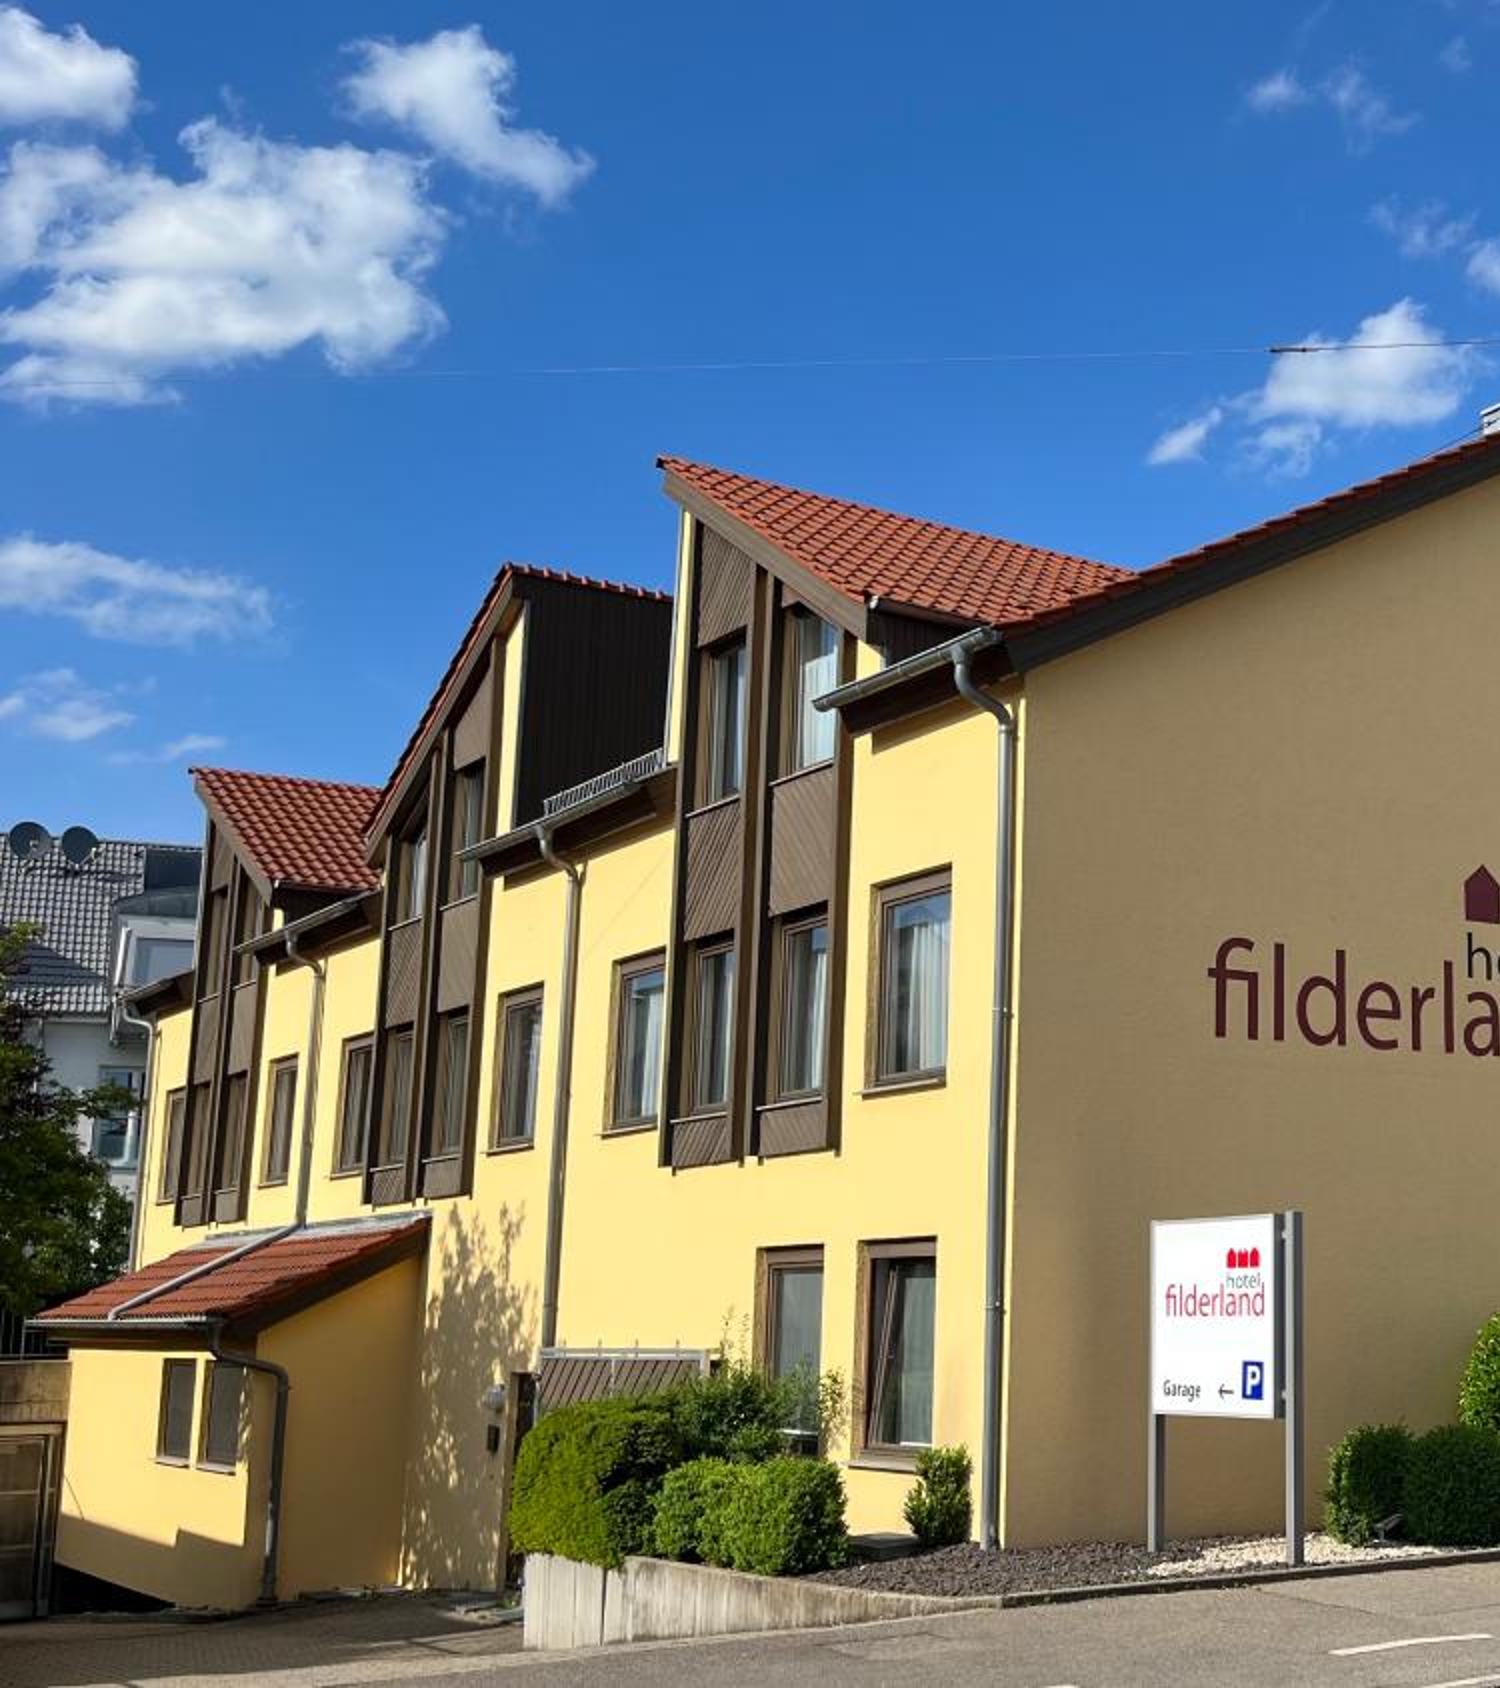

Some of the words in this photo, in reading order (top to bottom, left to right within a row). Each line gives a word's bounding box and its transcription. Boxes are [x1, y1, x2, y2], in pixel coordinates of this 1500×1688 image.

[1226, 1273, 1260, 1288] hotel
[1165, 1283, 1264, 1316] filderland
[1163, 1379, 1201, 1402] Garage
[1246, 1365, 1260, 1396] P
